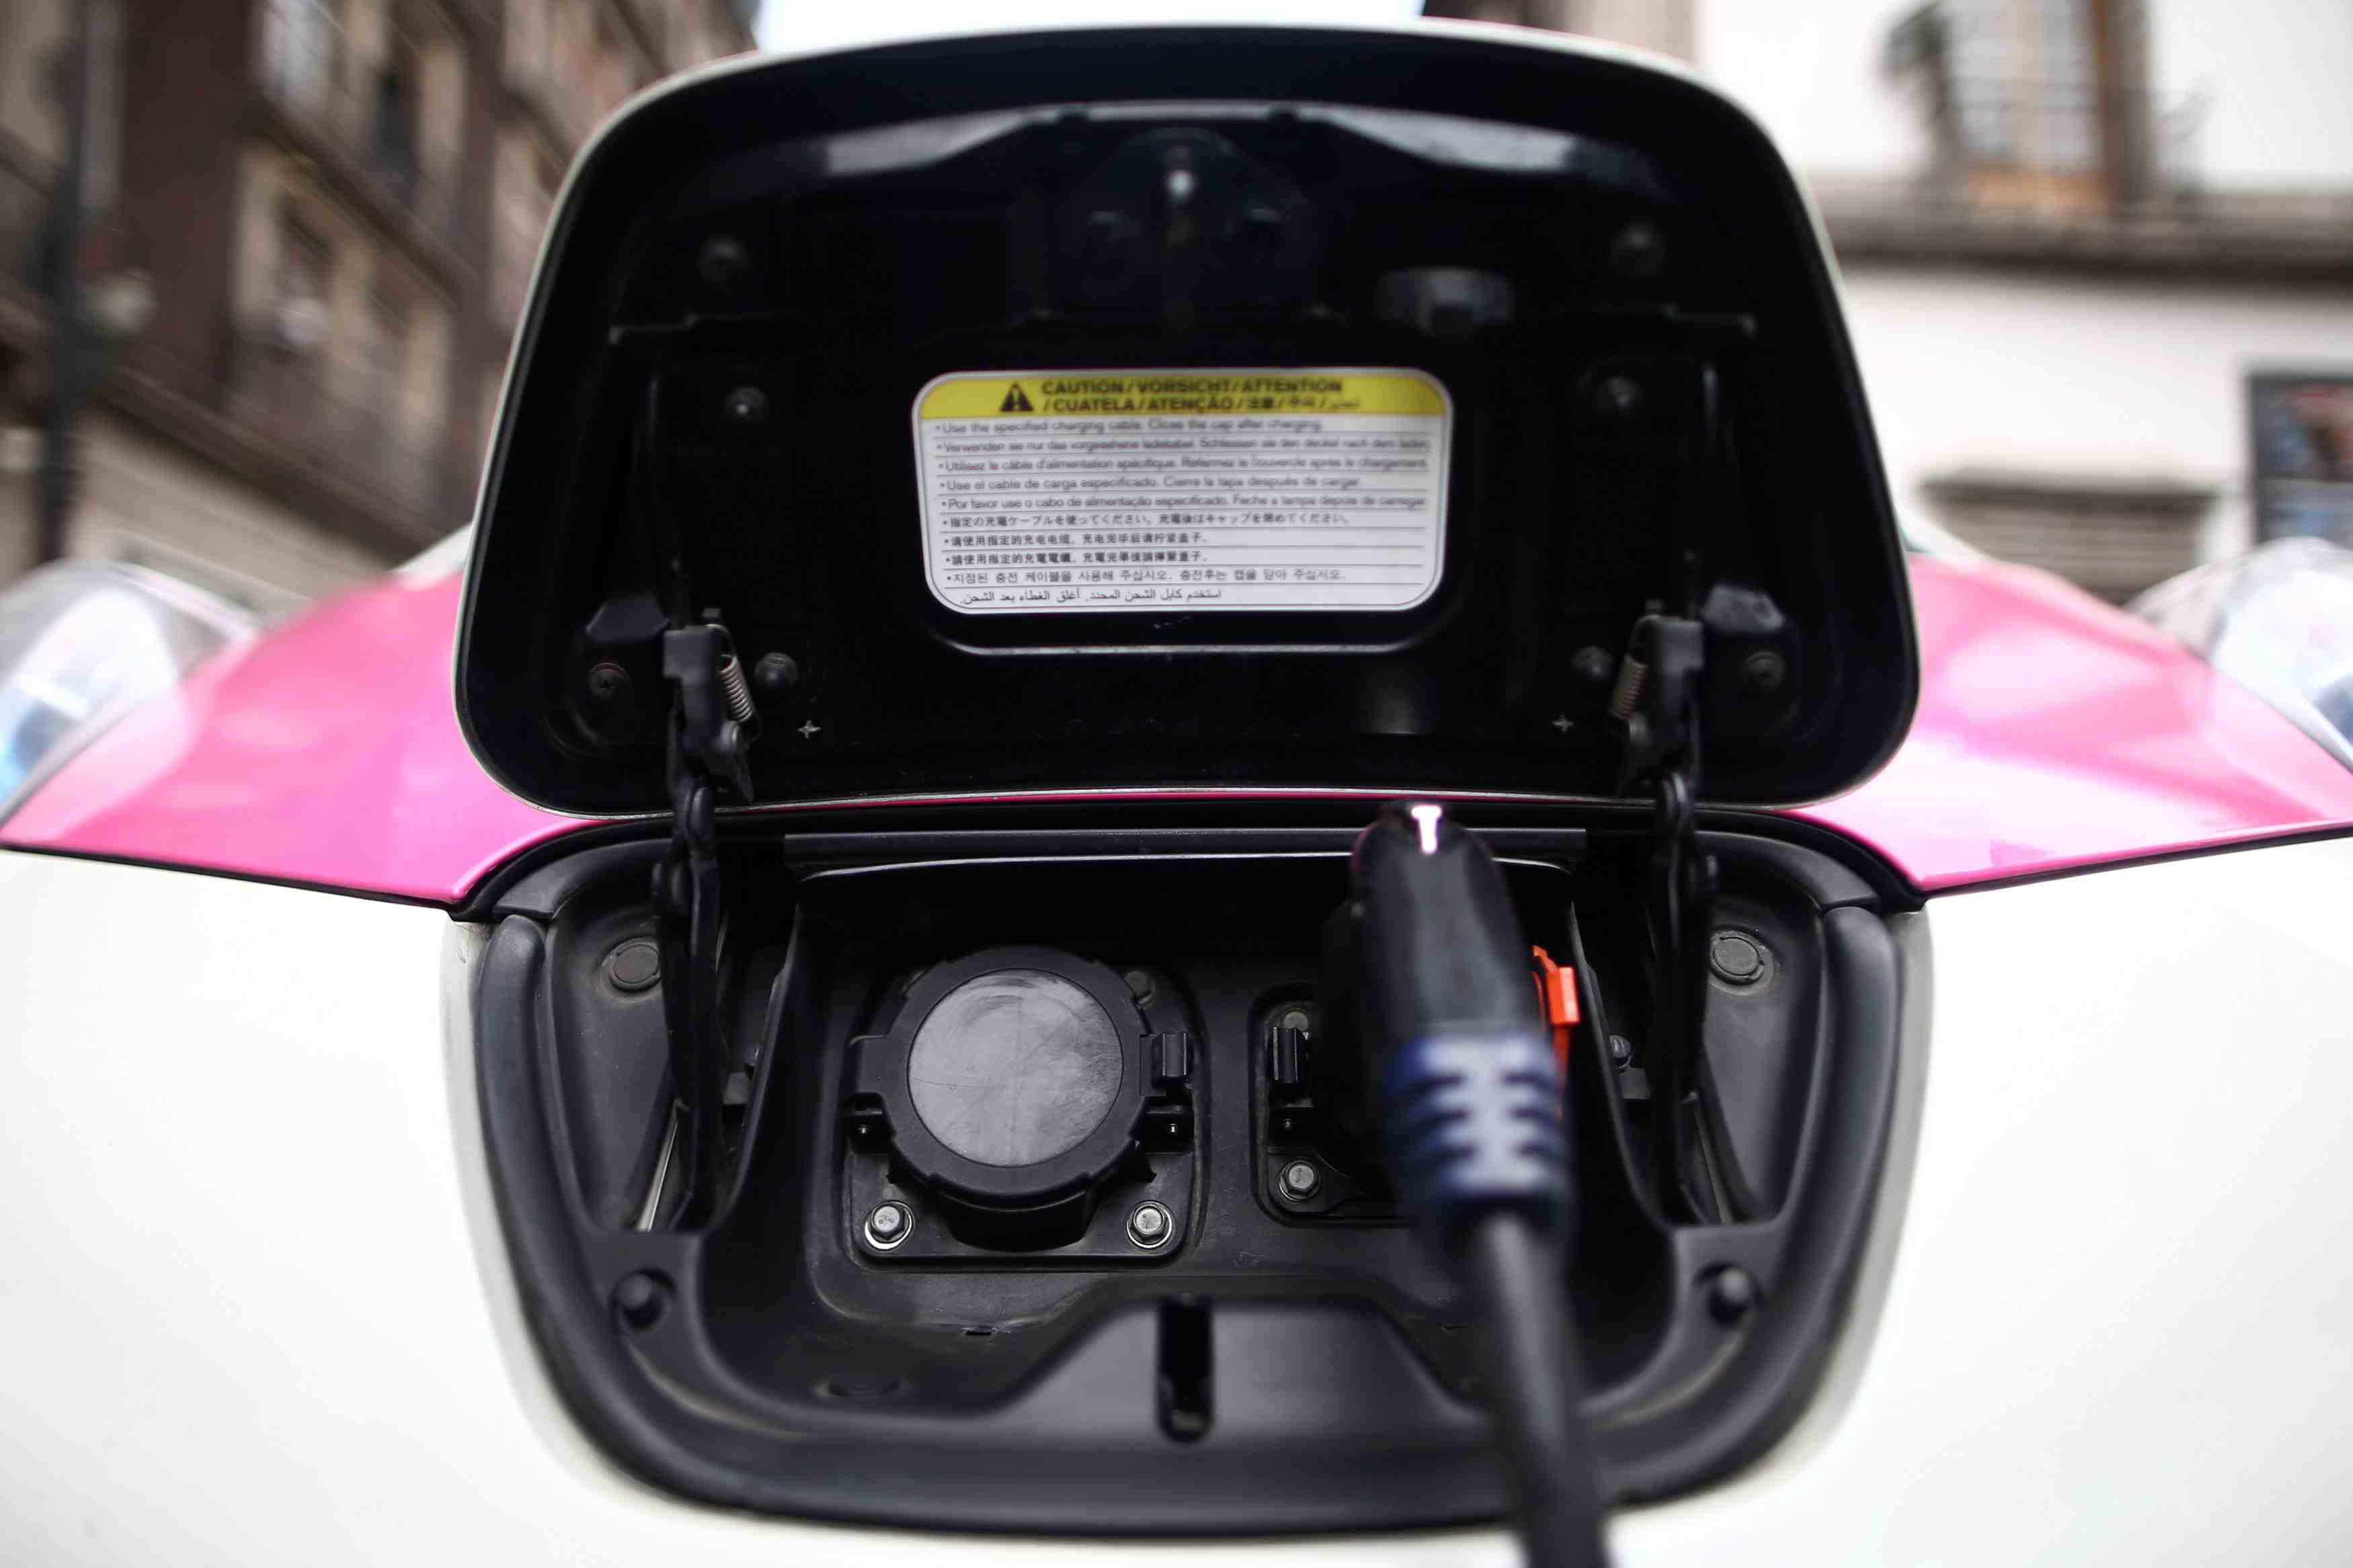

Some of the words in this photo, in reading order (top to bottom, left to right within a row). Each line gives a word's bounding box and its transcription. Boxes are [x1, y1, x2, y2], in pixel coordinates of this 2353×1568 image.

[943, 422, 966, 433] Use
[971, 421, 989, 431] the
[994, 420, 1047, 434] specified
[1053, 420, 1104, 435] charging
[1148, 418, 1184, 430] Close
[1188, 419, 1206, 429] the
[944, 440, 1004, 452] Verwenden
[1027, 441, 1043, 450] nur
[1047, 440, 1067, 450] das
[946, 460, 985, 471] Utilisez
[990, 460, 998, 470] le
[947, 479, 970, 490] Use
[974, 478, 986, 489] el
[988, 478, 1021, 489] cable
[1024, 477, 1040, 489] de
[1043, 479, 1078, 492] carga
[1204, 475, 1214, 486] la
[1302, 475, 1318, 486] de
[948, 499, 967, 509] Por
[971, 497, 998, 509] favor
[1002, 499, 1023, 508] use
[1025, 499, 1033, 508] o
[1035, 497, 1064, 508] cabo
[1067, 497, 1082, 507] de
[953, 572, 988, 585] 지정된
